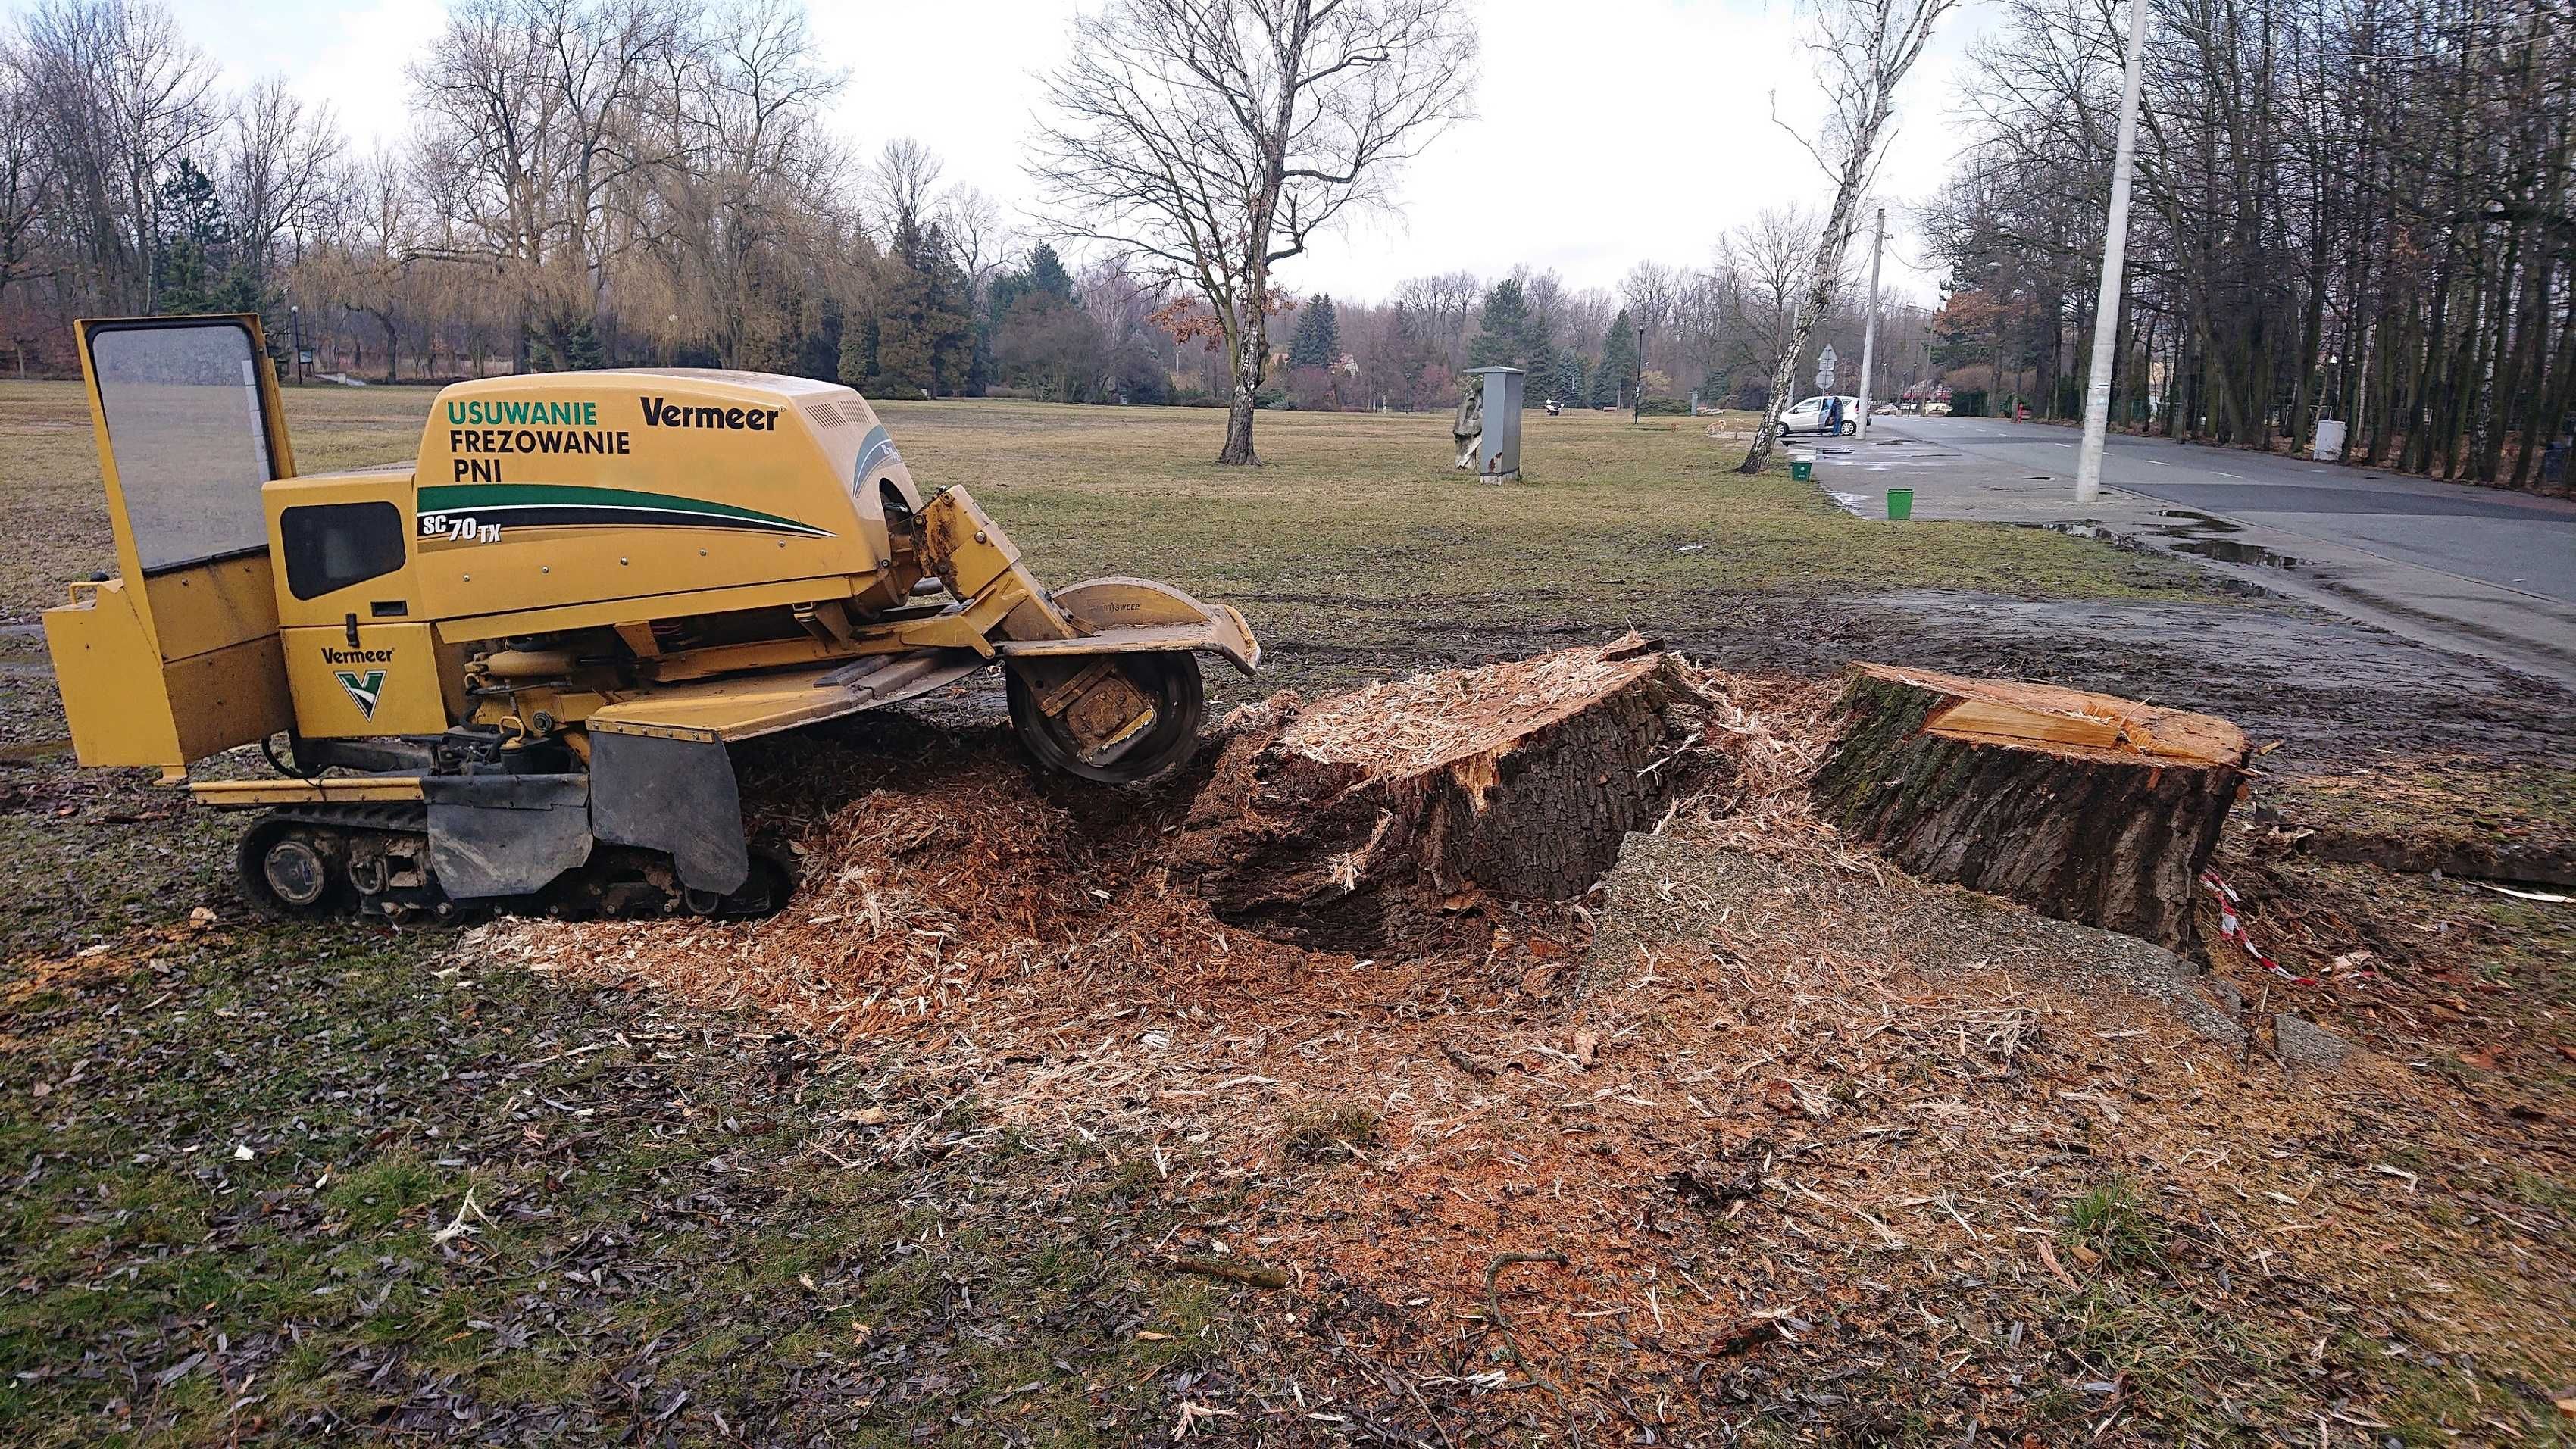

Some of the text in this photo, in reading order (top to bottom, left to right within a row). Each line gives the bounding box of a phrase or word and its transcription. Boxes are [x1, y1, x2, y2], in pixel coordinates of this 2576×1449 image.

[448, 401, 597, 425] USUWANIE
[640, 397, 778, 431] Vermeer
[450, 430, 630, 454] FREZOWANIE
[454, 459, 502, 482] PNI
[423, 515, 501, 544] SC 70 TX
[321, 648, 392, 664] Vermeer
